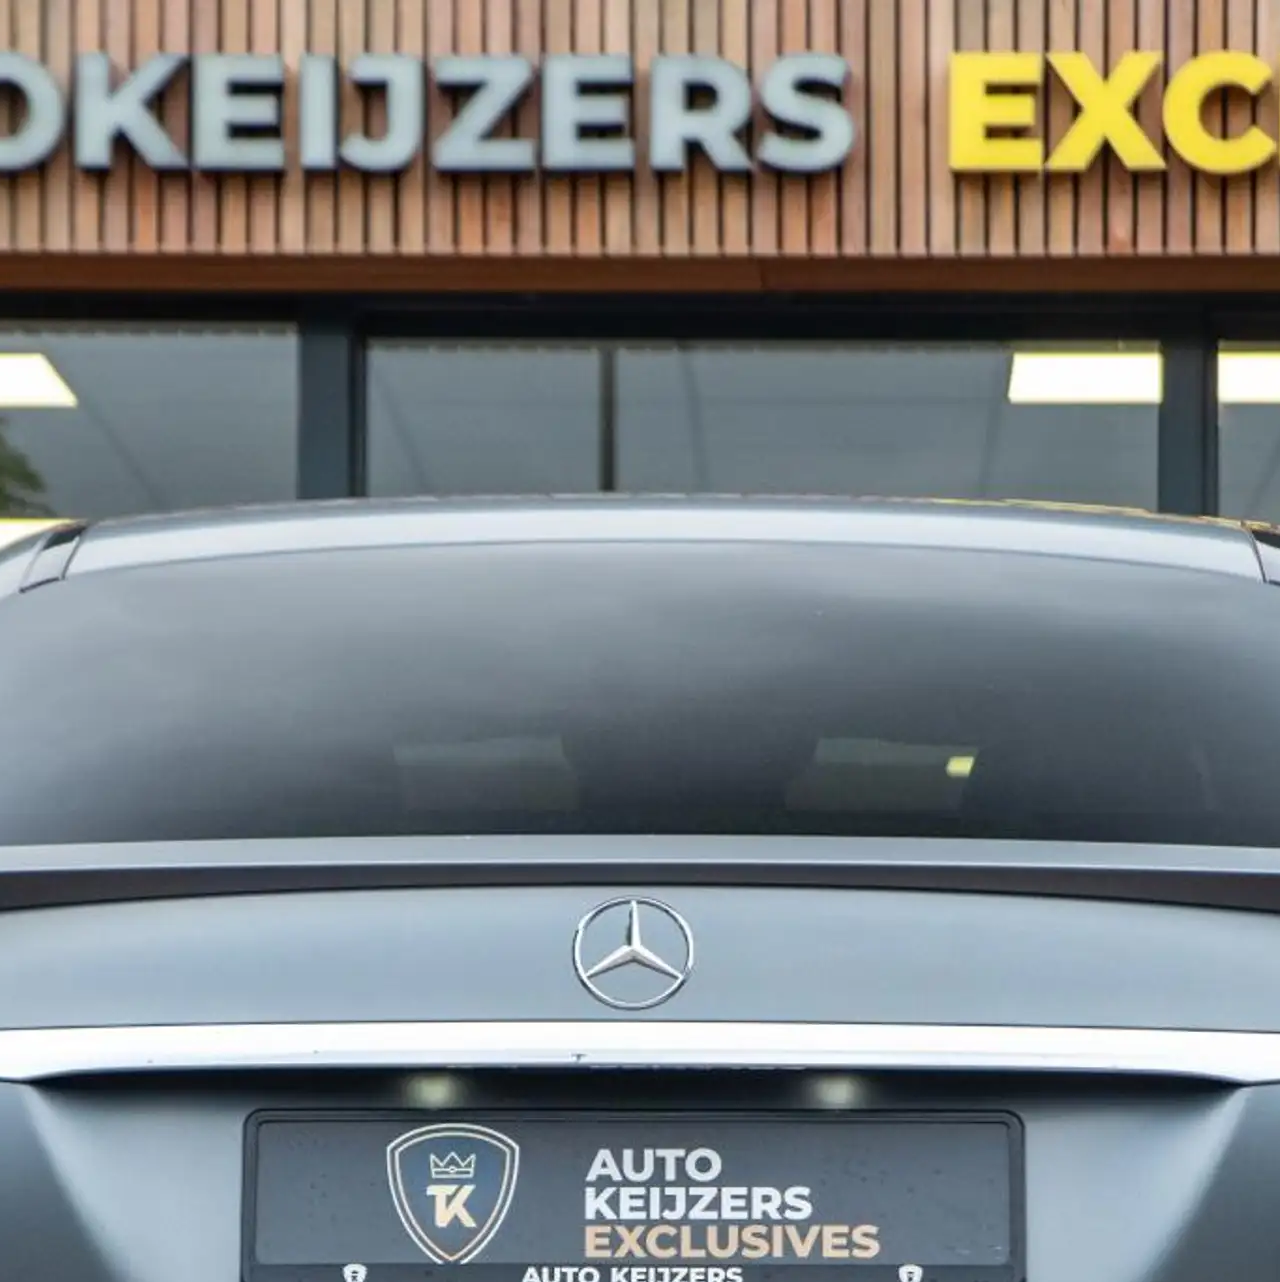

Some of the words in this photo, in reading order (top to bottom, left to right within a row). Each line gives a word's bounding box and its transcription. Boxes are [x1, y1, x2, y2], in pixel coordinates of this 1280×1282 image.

[585, 1148, 723, 1182] AUTO
[585, 1186, 813, 1221] KEIJZERS
[584, 1224, 881, 1259] EXCLUSIVES
